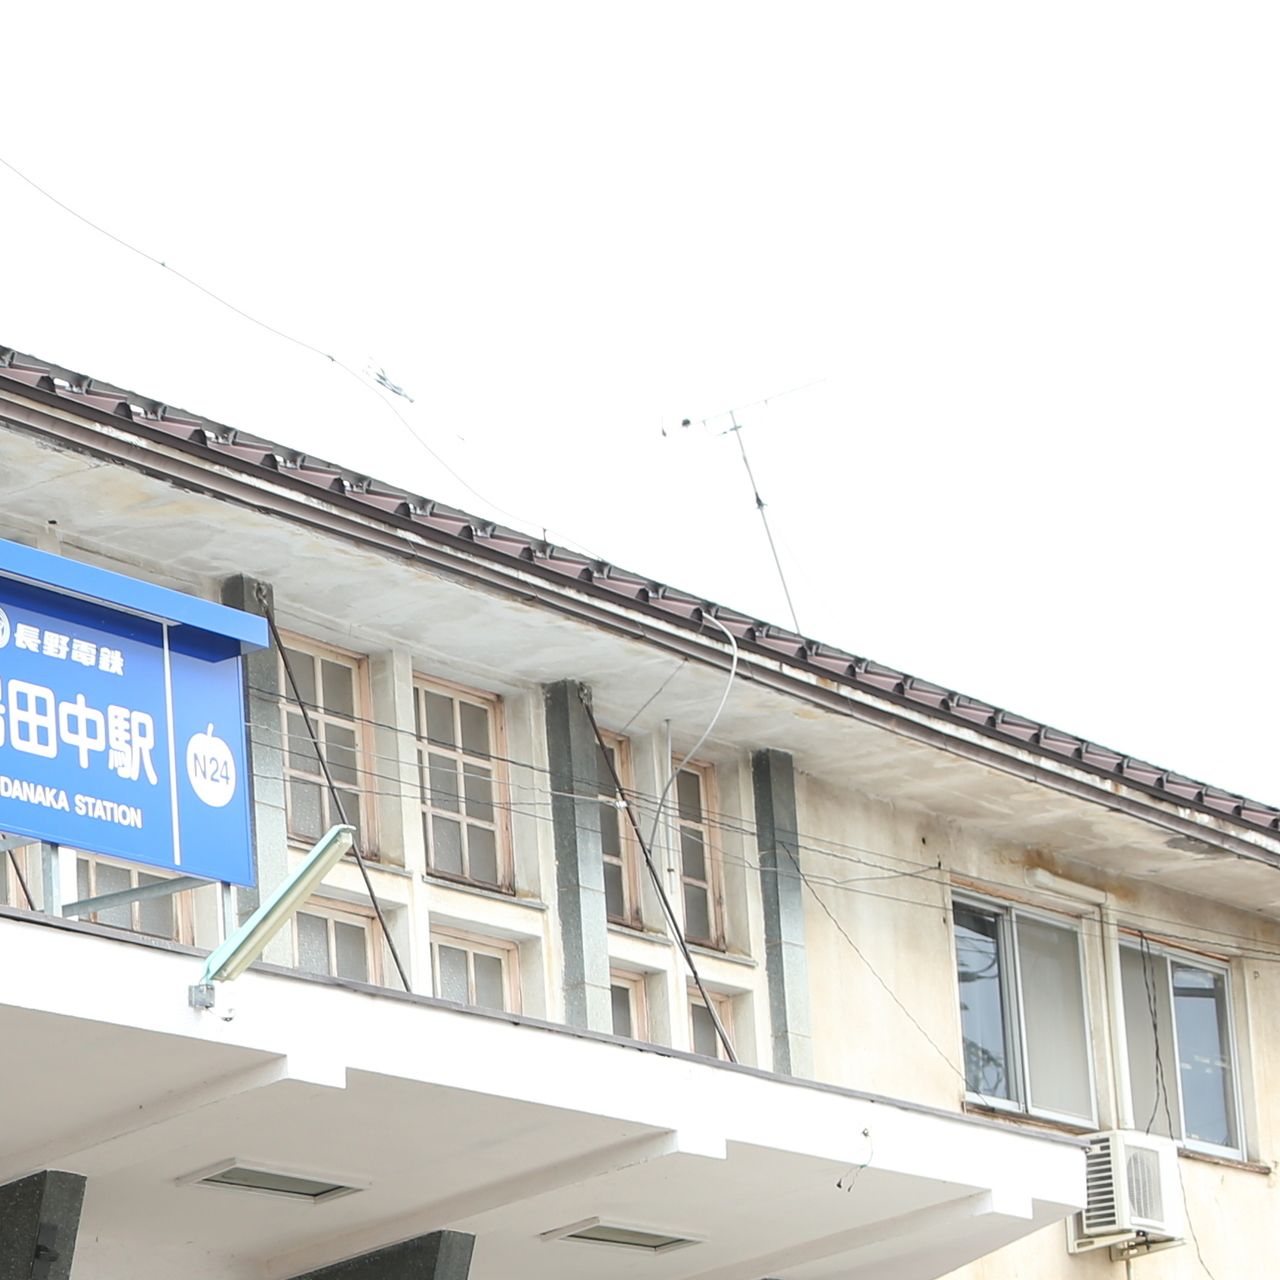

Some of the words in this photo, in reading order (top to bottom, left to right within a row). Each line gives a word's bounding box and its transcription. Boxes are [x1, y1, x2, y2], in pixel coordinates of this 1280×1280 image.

[14, 622, 125, 677] 長野電鉄
[192, 751, 232, 786] N24
[74, 796, 143, 830] STATION
